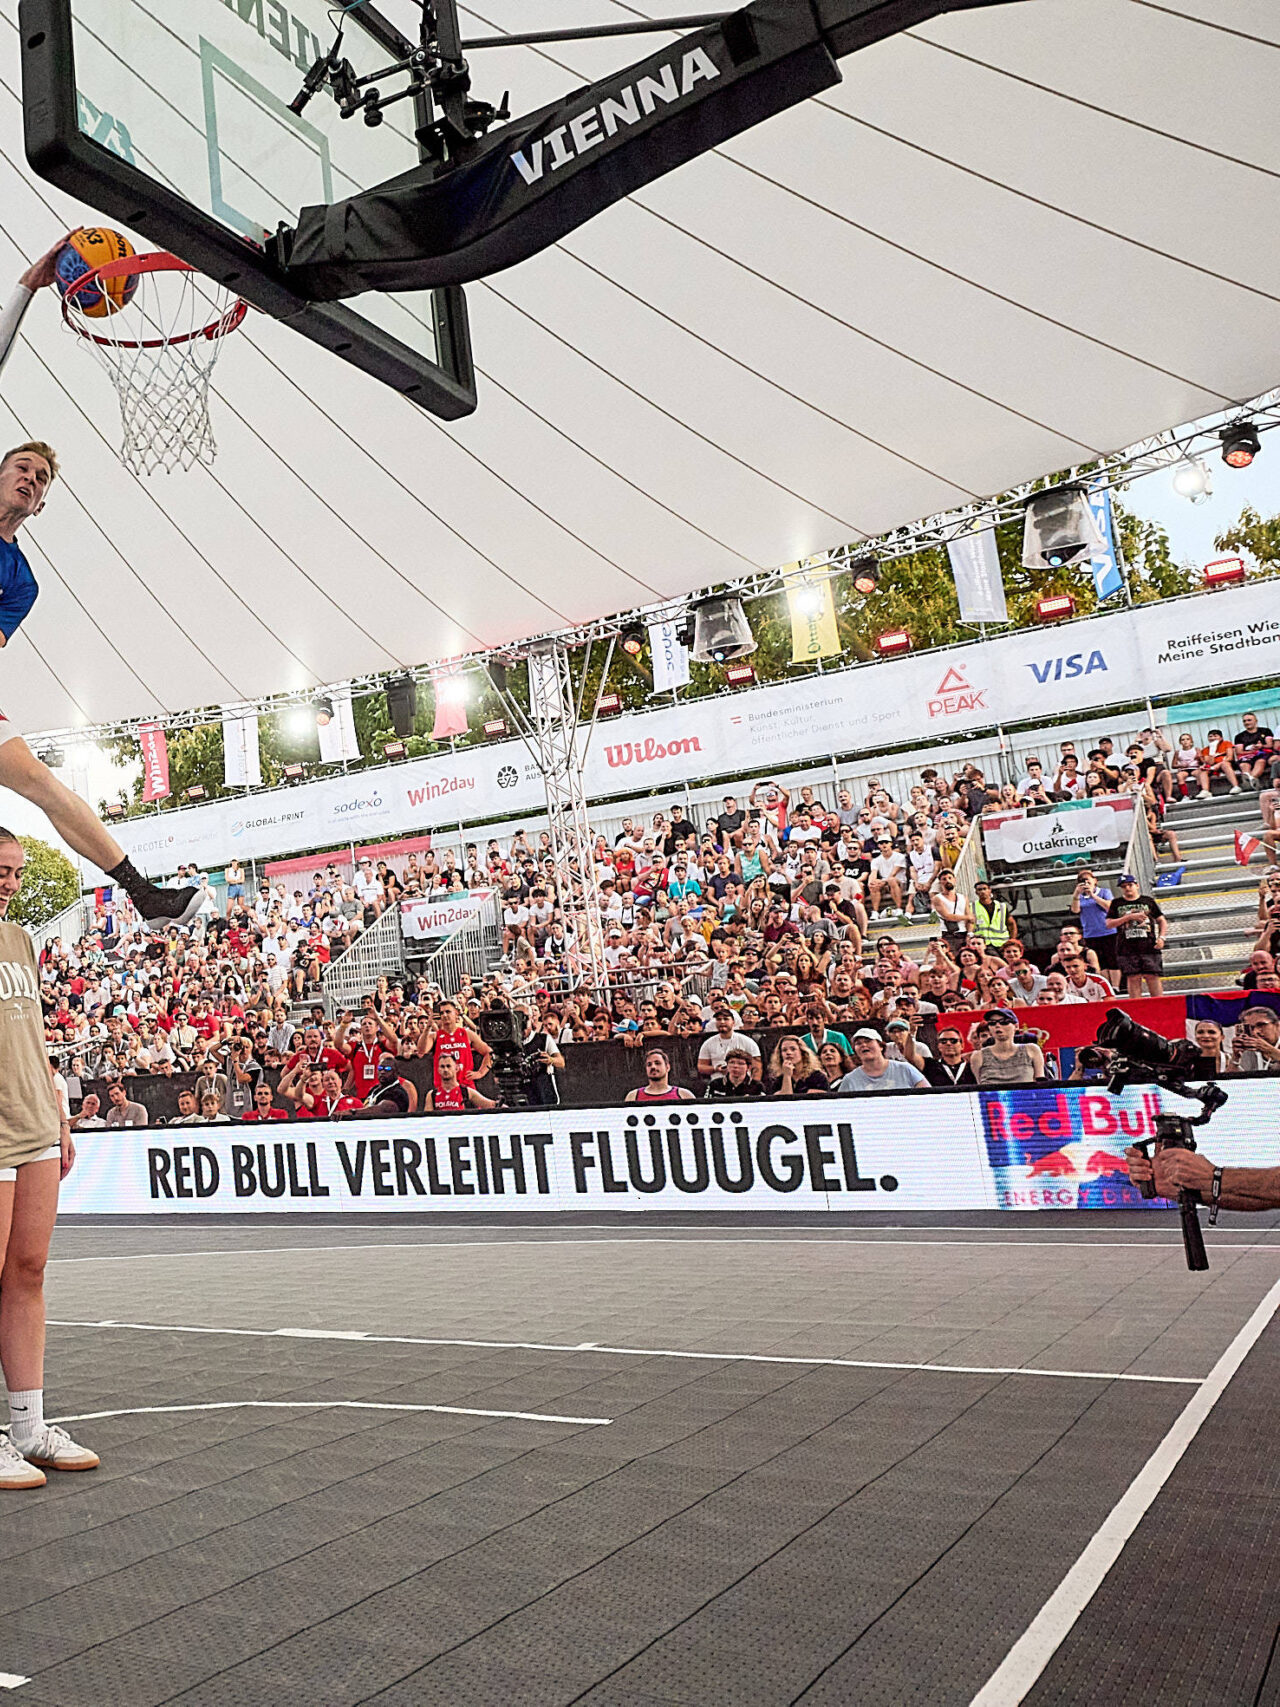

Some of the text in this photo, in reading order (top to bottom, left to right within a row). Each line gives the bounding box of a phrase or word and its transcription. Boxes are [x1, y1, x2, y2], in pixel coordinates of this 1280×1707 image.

[510, 46, 721, 185] VIENNA
[1167, 628, 1243, 650] Raiffeisen
[1023, 650, 1109, 683] VISA
[1158, 649, 1205, 664] Meine
[748, 696, 843, 722] Bundesministerium
[927, 689, 989, 719] PEAK
[848, 714, 869, 727] und
[872, 709, 901, 723] Sport
[604, 735, 702, 768] Wilson
[333, 795, 382, 815] sodexo
[245, 811, 305, 830] GLOBAL-PRINT
[131, 840, 169, 854] ARCOTEL
[1022, 834, 1098, 854] Ottakringer
[440, 1042, 467, 1050] POLSKA
[986, 1093, 1162, 1141] Red Bull
[148, 1111, 899, 1199] RED BULL VERLEIHT FLÜÜÜGEL.
